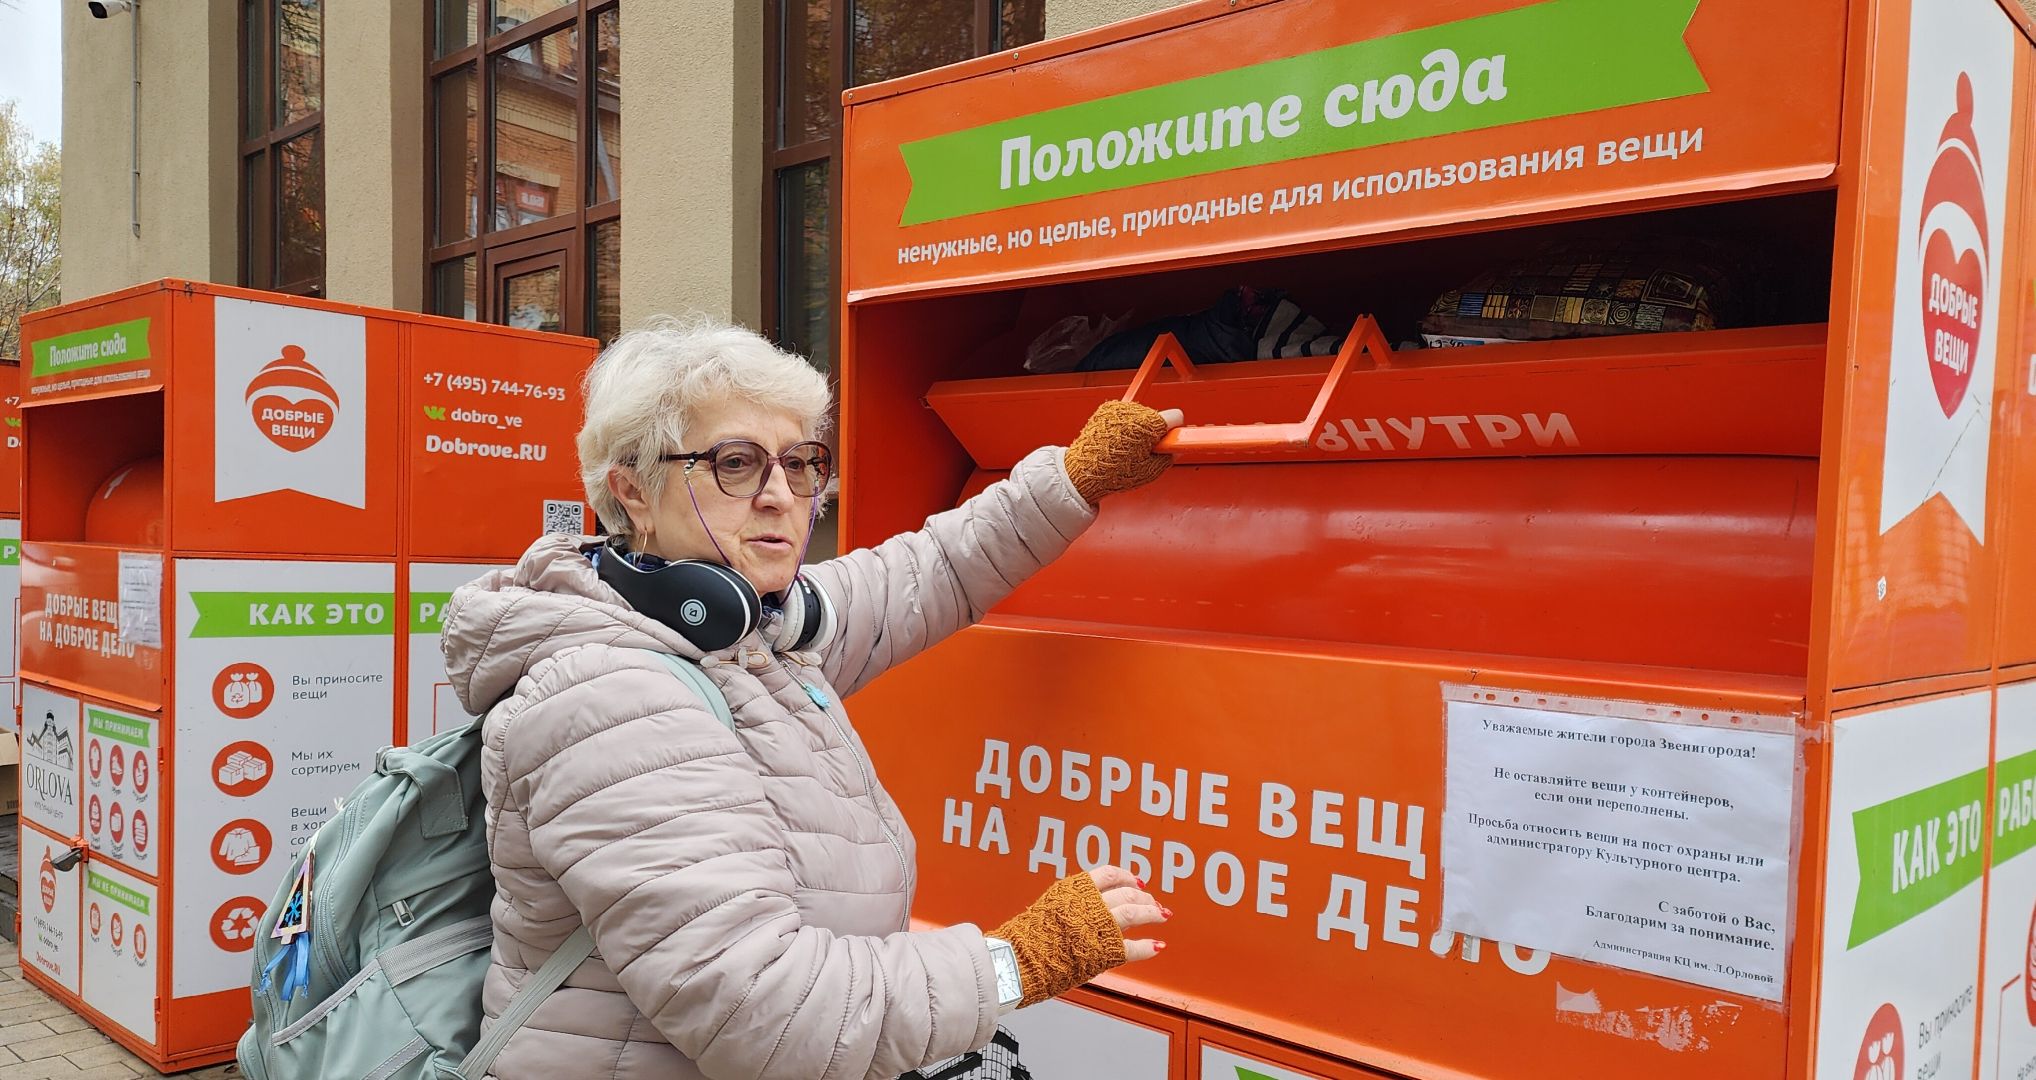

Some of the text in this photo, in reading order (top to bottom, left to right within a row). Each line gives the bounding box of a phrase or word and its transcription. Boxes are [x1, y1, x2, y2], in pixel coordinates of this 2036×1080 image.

[1000, 48, 1507, 190] Положите сюда
[898, 127, 1703, 265] ненужные, но целые, пригодные для использования вещи
[1929, 272, 1977, 329] ДОБРЫЕ
[50, 332, 127, 367] Положите сюда
[1934, 328, 1969, 376] ВЕЩИ
[423, 372, 566, 402] +7 (495) 744-76-93
[261, 407, 325, 424] ДОБРЫЕ
[271, 424, 315, 440] ВЕЩИ
[451, 408, 522, 430] dobro_ve
[426, 435, 547, 462] Dobrove.RU
[45, 593, 89, 619] ДОБРЫЕ
[92, 599, 119, 629] ВЕЩ
[250, 603, 315, 625] КАК
[326, 603, 385, 624] ЭТО
[40, 620, 53, 642] НА
[55, 623, 99, 651] ДОБРОЕ
[292, 672, 383, 687] Вы приносите
[292, 688, 327, 701] вещи
[291, 750, 334, 761] Мы их
[1482, 719, 1756, 758] Уважаемые жители города Звенигорода!
[26, 763, 73, 806] ORLOVA
[291, 762, 360, 777] сортируем
[1493, 767, 1734, 810] Не оставляйте вещи у контейнеров,
[1534, 791, 1689, 820] если они переполнены.
[291, 806, 327, 817] Вещи
[974, 739, 1426, 880] ДОБРЫЕ ВЕЩ
[1468, 812, 1764, 867] Просьба относить вещи на пост охраны или
[1891, 776, 2036, 895] КАК ЭТО РАБ
[942, 798, 1010, 855] НА
[1028, 815, 1289, 918] ДОБРОЕ
[1486, 833, 1741, 884] администратору Культурного центра.
[1586, 905, 1775, 951] Благодарим за понимание.
[1658, 900, 1776, 934] С заботой о Вас,
[1593, 939, 1774, 984] Администрация КЦ им. Л.Орловой
